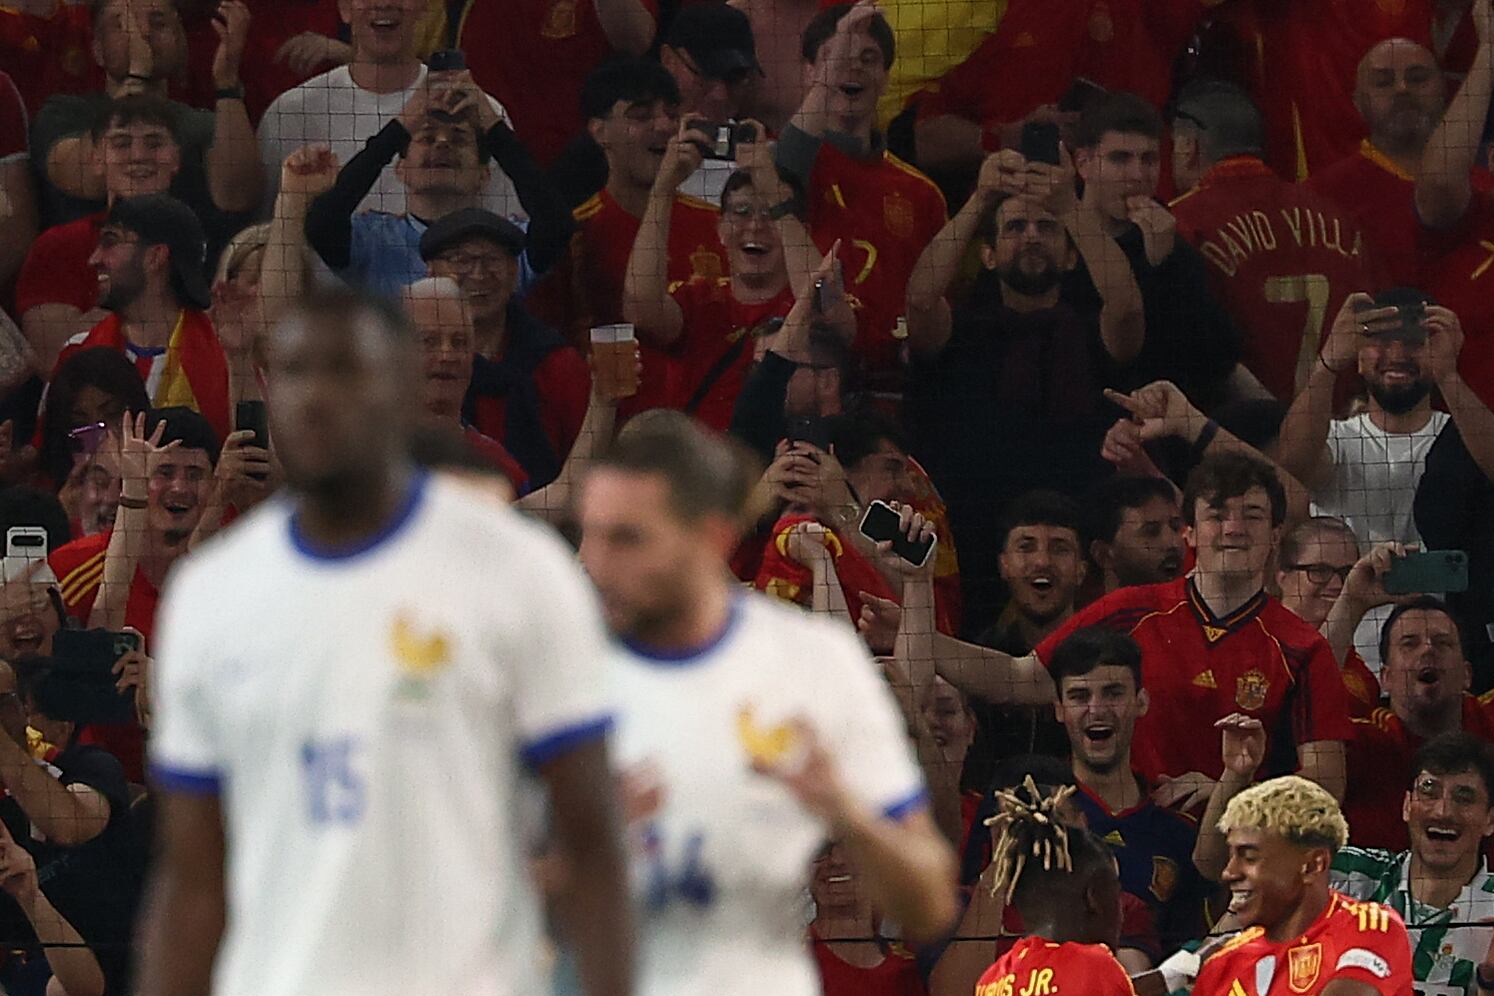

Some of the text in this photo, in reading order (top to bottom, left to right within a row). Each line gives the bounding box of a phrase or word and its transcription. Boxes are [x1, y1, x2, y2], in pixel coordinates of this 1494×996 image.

[851, 239, 878, 284] 7
[1201, 211, 1276, 277] DAVID
[1264, 274, 1330, 400] 7
[299, 736, 367, 826] 15
